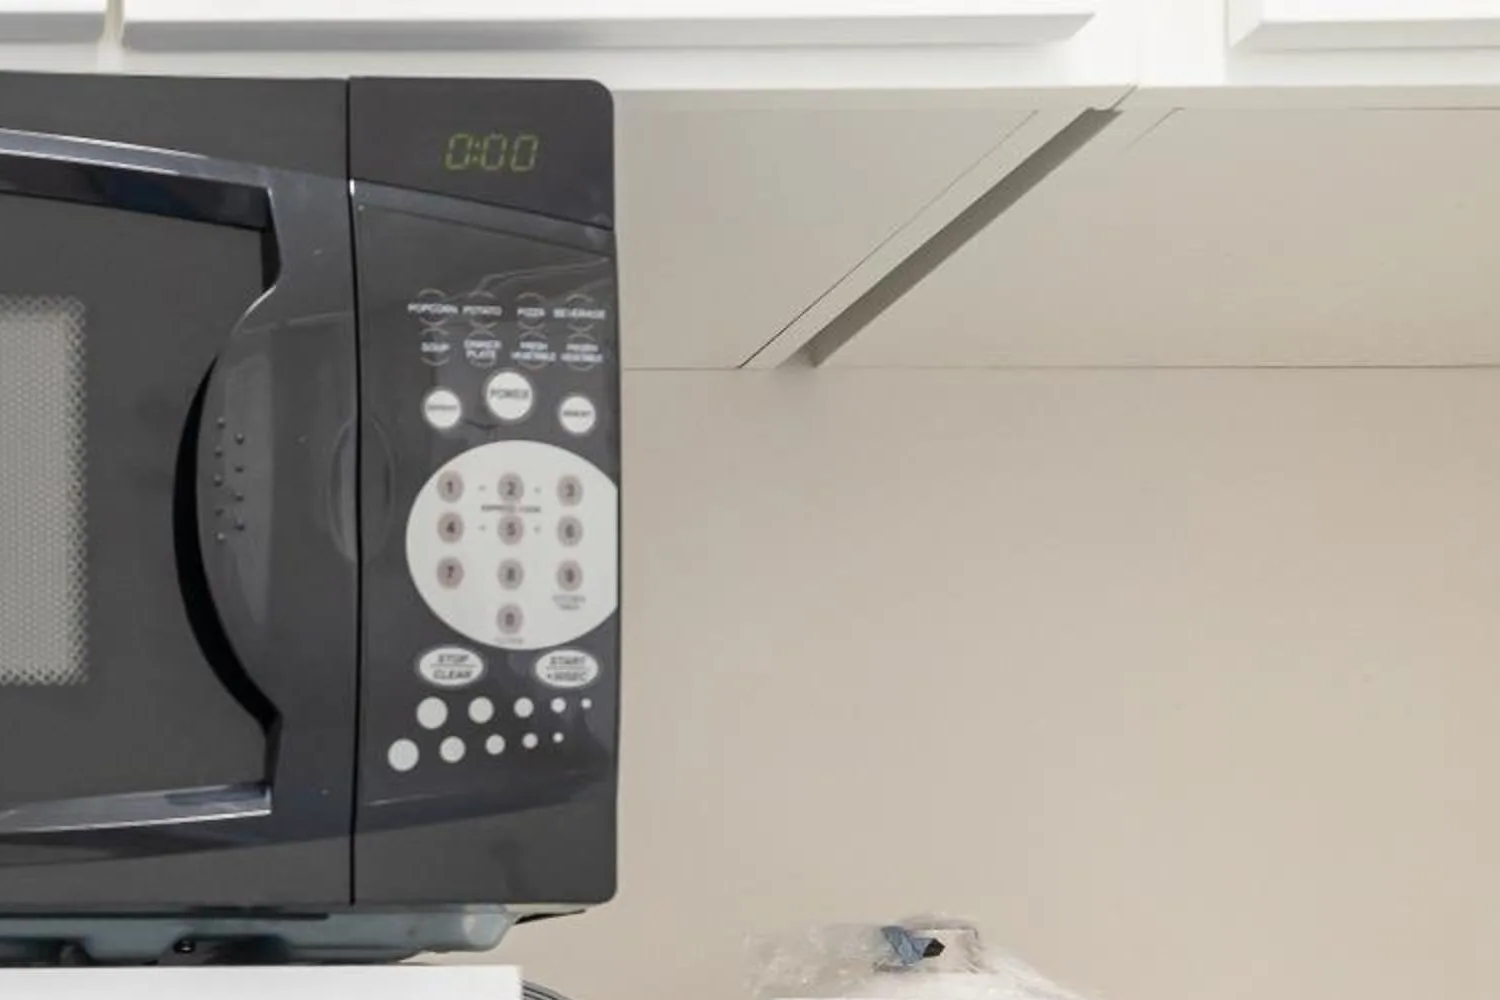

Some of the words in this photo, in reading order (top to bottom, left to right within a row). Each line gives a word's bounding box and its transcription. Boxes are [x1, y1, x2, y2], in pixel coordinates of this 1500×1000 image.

[446, 133, 539, 171] 0:00
[407, 303, 459, 315] POPCORN
[437, 654, 470, 663] STOP
[550, 656, 586, 665] START
[433, 670, 472, 680] CLEAR
